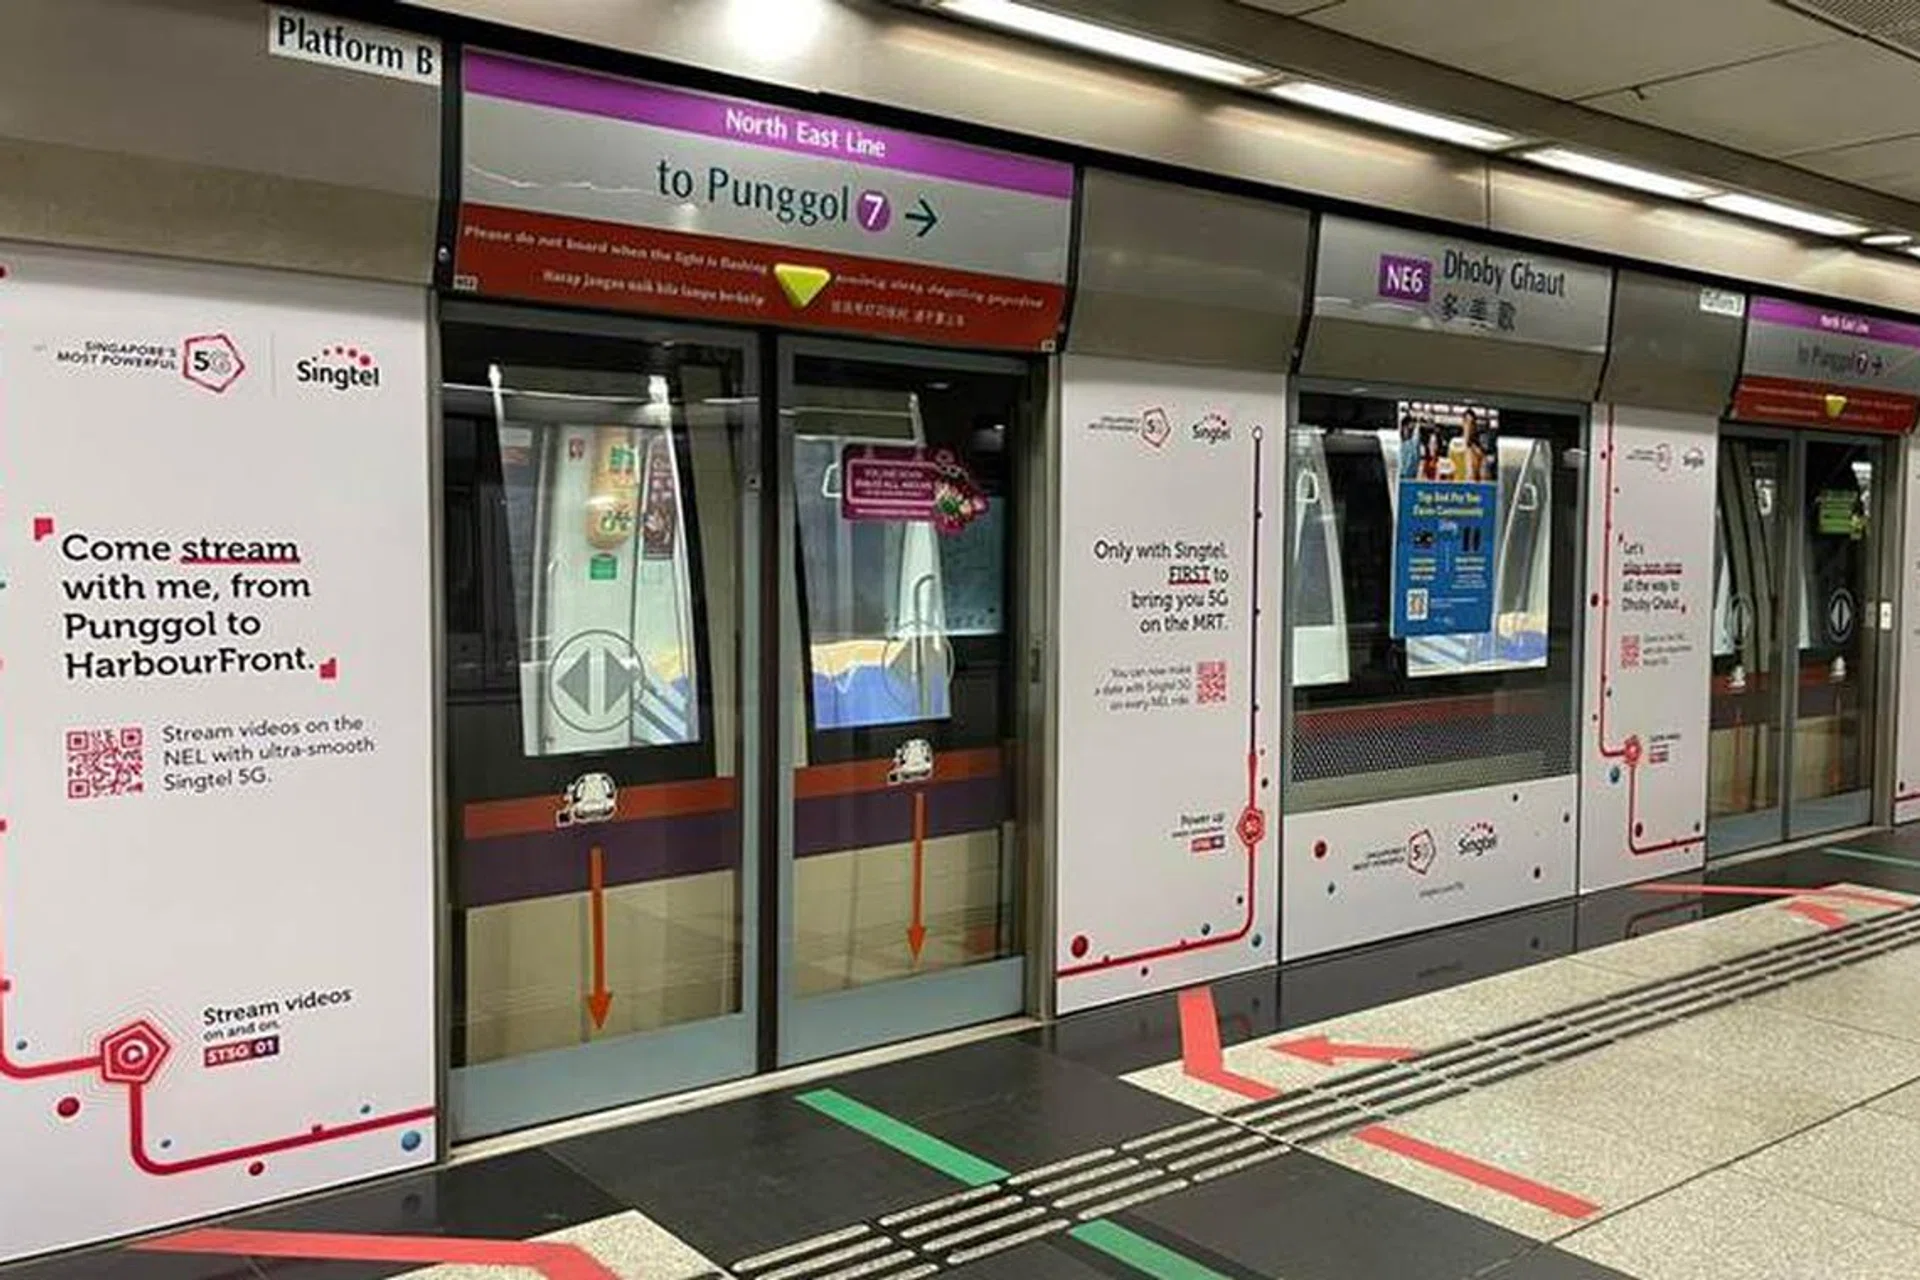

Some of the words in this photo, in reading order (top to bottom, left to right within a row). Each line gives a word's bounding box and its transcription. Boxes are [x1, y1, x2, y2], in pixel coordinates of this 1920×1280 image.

[278, 15, 403, 70] Platform
[417, 45, 433, 75] B
[726, 108, 787, 140] North
[796, 121, 838, 149] East
[846, 130, 885, 158] Line
[657, 160, 692, 198] to
[708, 167, 848, 228] Punggol
[863, 193, 884, 227] 7
[464, 225, 512, 243] Please
[515, 231, 535, 245] do
[538, 235, 562, 248] not
[566, 238, 607, 254] board
[611, 243, 648, 260] when
[650, 247, 671, 262] the
[675, 250, 704, 267] light
[1386, 265, 1424, 294] NE6
[1443, 250, 1505, 294] Dhoby
[1510, 261, 1565, 297] Ghaut
[57, 351, 97, 364] MOST
[102, 355, 177, 370] POWERFUL
[297, 357, 379, 390] Singtel
[1192, 422, 1231, 445] Singtel
[62, 534, 171, 562] Come
[181, 536, 300, 563] stream
[1094, 540, 1134, 564] Only
[1136, 542, 1172, 559] with
[62, 573, 146, 601] with
[157, 577, 220, 602] me,
[231, 573, 311, 599] from
[1169, 565, 1211, 585] FIRST
[1214, 567, 1230, 582] to
[1131, 590, 1173, 612] bring
[1175, 594, 1205, 612] you
[1208, 588, 1230, 608] 5G
[65, 611, 217, 645] Punggol
[227, 612, 262, 635] to
[1140, 618, 1161, 633] on
[1164, 614, 1190, 632] the
[1192, 612, 1229, 631] MRT.
[66, 647, 315, 680] HarbourFront.
[162, 724, 233, 744] Stream
[239, 719, 300, 737] videos
[305, 720, 329, 734] on
[333, 715, 364, 732] the
[163, 747, 207, 767] NEL
[212, 744, 254, 762] with
[259, 737, 375, 760] ultra-smooth
[164, 769, 233, 793] Singtel
[238, 766, 272, 785] 5G.
[1458, 834, 1497, 857] Singtel
[203, 1001, 280, 1026] Stream
[285, 989, 354, 1011] videos
[203, 1029, 224, 1042] on
[228, 1020, 256, 1038] and
